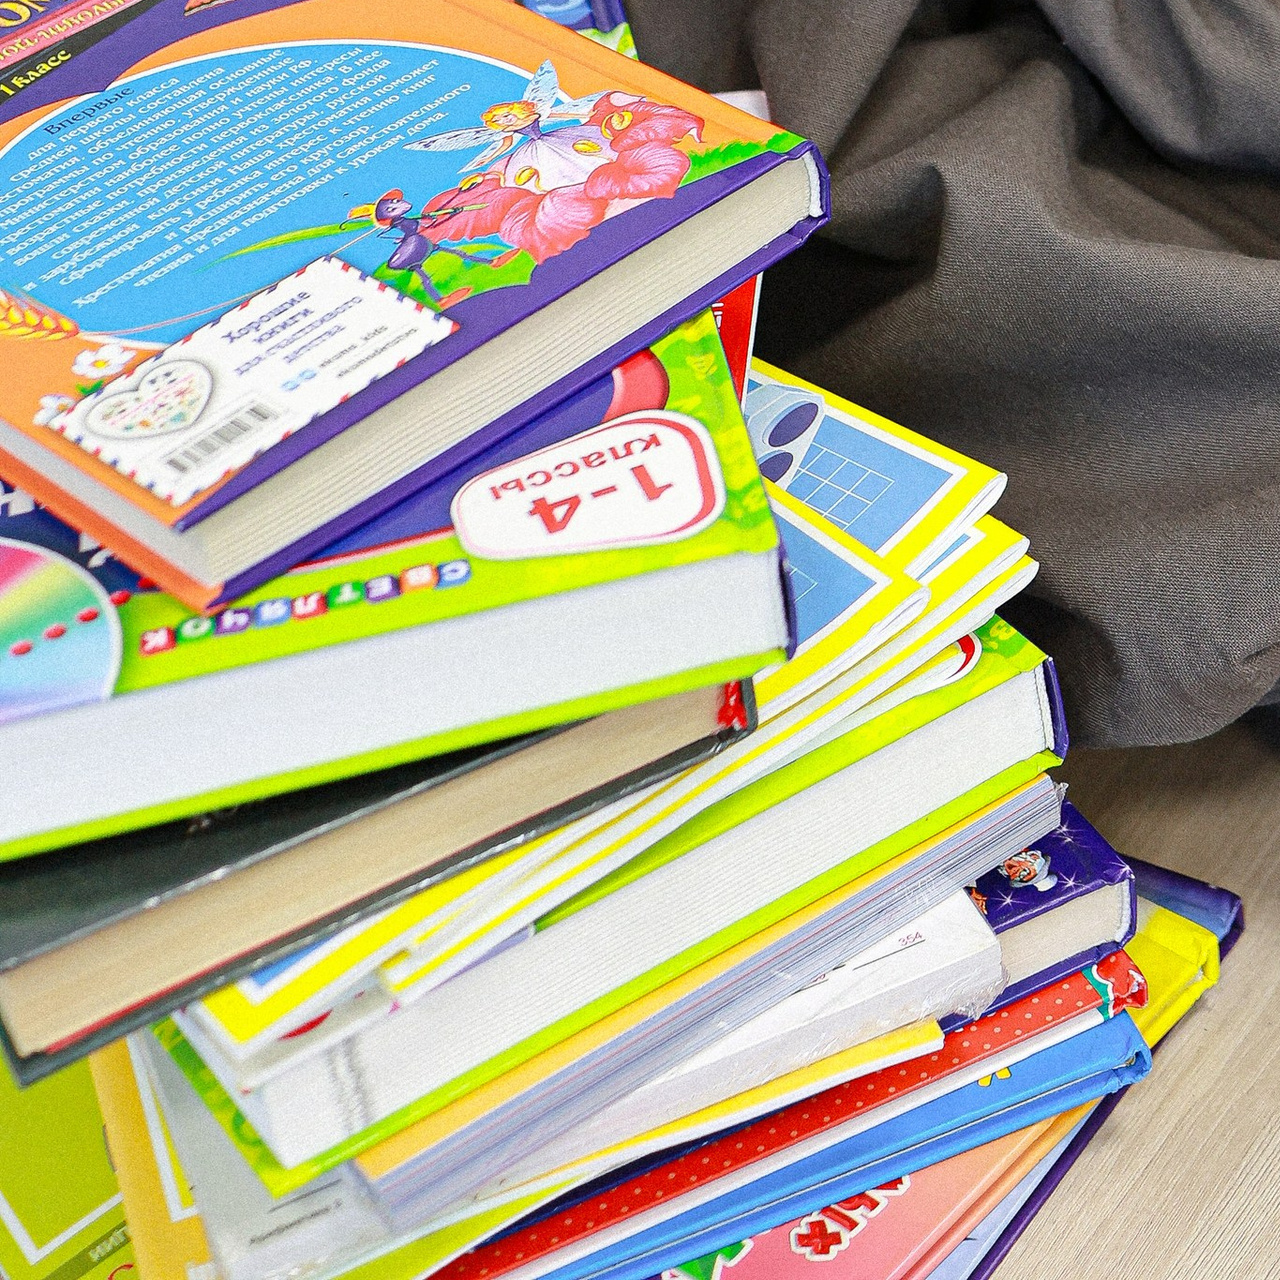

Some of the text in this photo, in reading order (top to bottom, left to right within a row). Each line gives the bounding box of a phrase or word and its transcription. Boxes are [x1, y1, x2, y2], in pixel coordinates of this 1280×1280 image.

[0, 84, 15, 96] 1
[10, 68, 225, 181] средней школы составлена
[28, 78, 180, 160] для первого класса
[43, 88, 134, 135] Впервые
[88, 90, 207, 153] объединяющая
[209, 49, 284, 89] основные
[91, 152, 115, 166] по
[182, 57, 294, 118] утвержденные
[104, 145, 180, 187] наиболее
[182, 118, 230, 144] полно
[232, 87, 288, 119] учтены
[290, 48, 363, 86] интересы
[0, 160, 126, 230] Министерством
[128, 105, 229, 159] образования
[229, 96, 244, 106] и
[245, 73, 290, 97] науки
[6, 51, 382, 256] возрастные потребности первоклассника. В нее
[14, 233, 70, 266] вошли
[136, 136, 248, 197] произведения
[248, 124, 270, 136] из
[271, 87, 339, 124] золотого
[342, 59, 391, 86] фонда
[21, 60, 439, 292] и зарубежной классики. Наша хрестоматия поможет
[51, 197, 161, 259] современной
[164, 161, 228, 199] детской
[326, 75, 387, 110] русской
[59, 75, 435, 285] сформировать у ребенка интерес к чтению книг
[72, 84, 471, 308] Хрестоматия предназначена для самостоятельного
[134, 113, 449, 286] чтения и для подготовки к урокам дома.
[163, 125, 374, 242] и расширить его кругозор.
[221, 291, 311, 343] Хорошие
[489, 433, 662, 500] классы
[529, 464, 673, 534] 1-4
